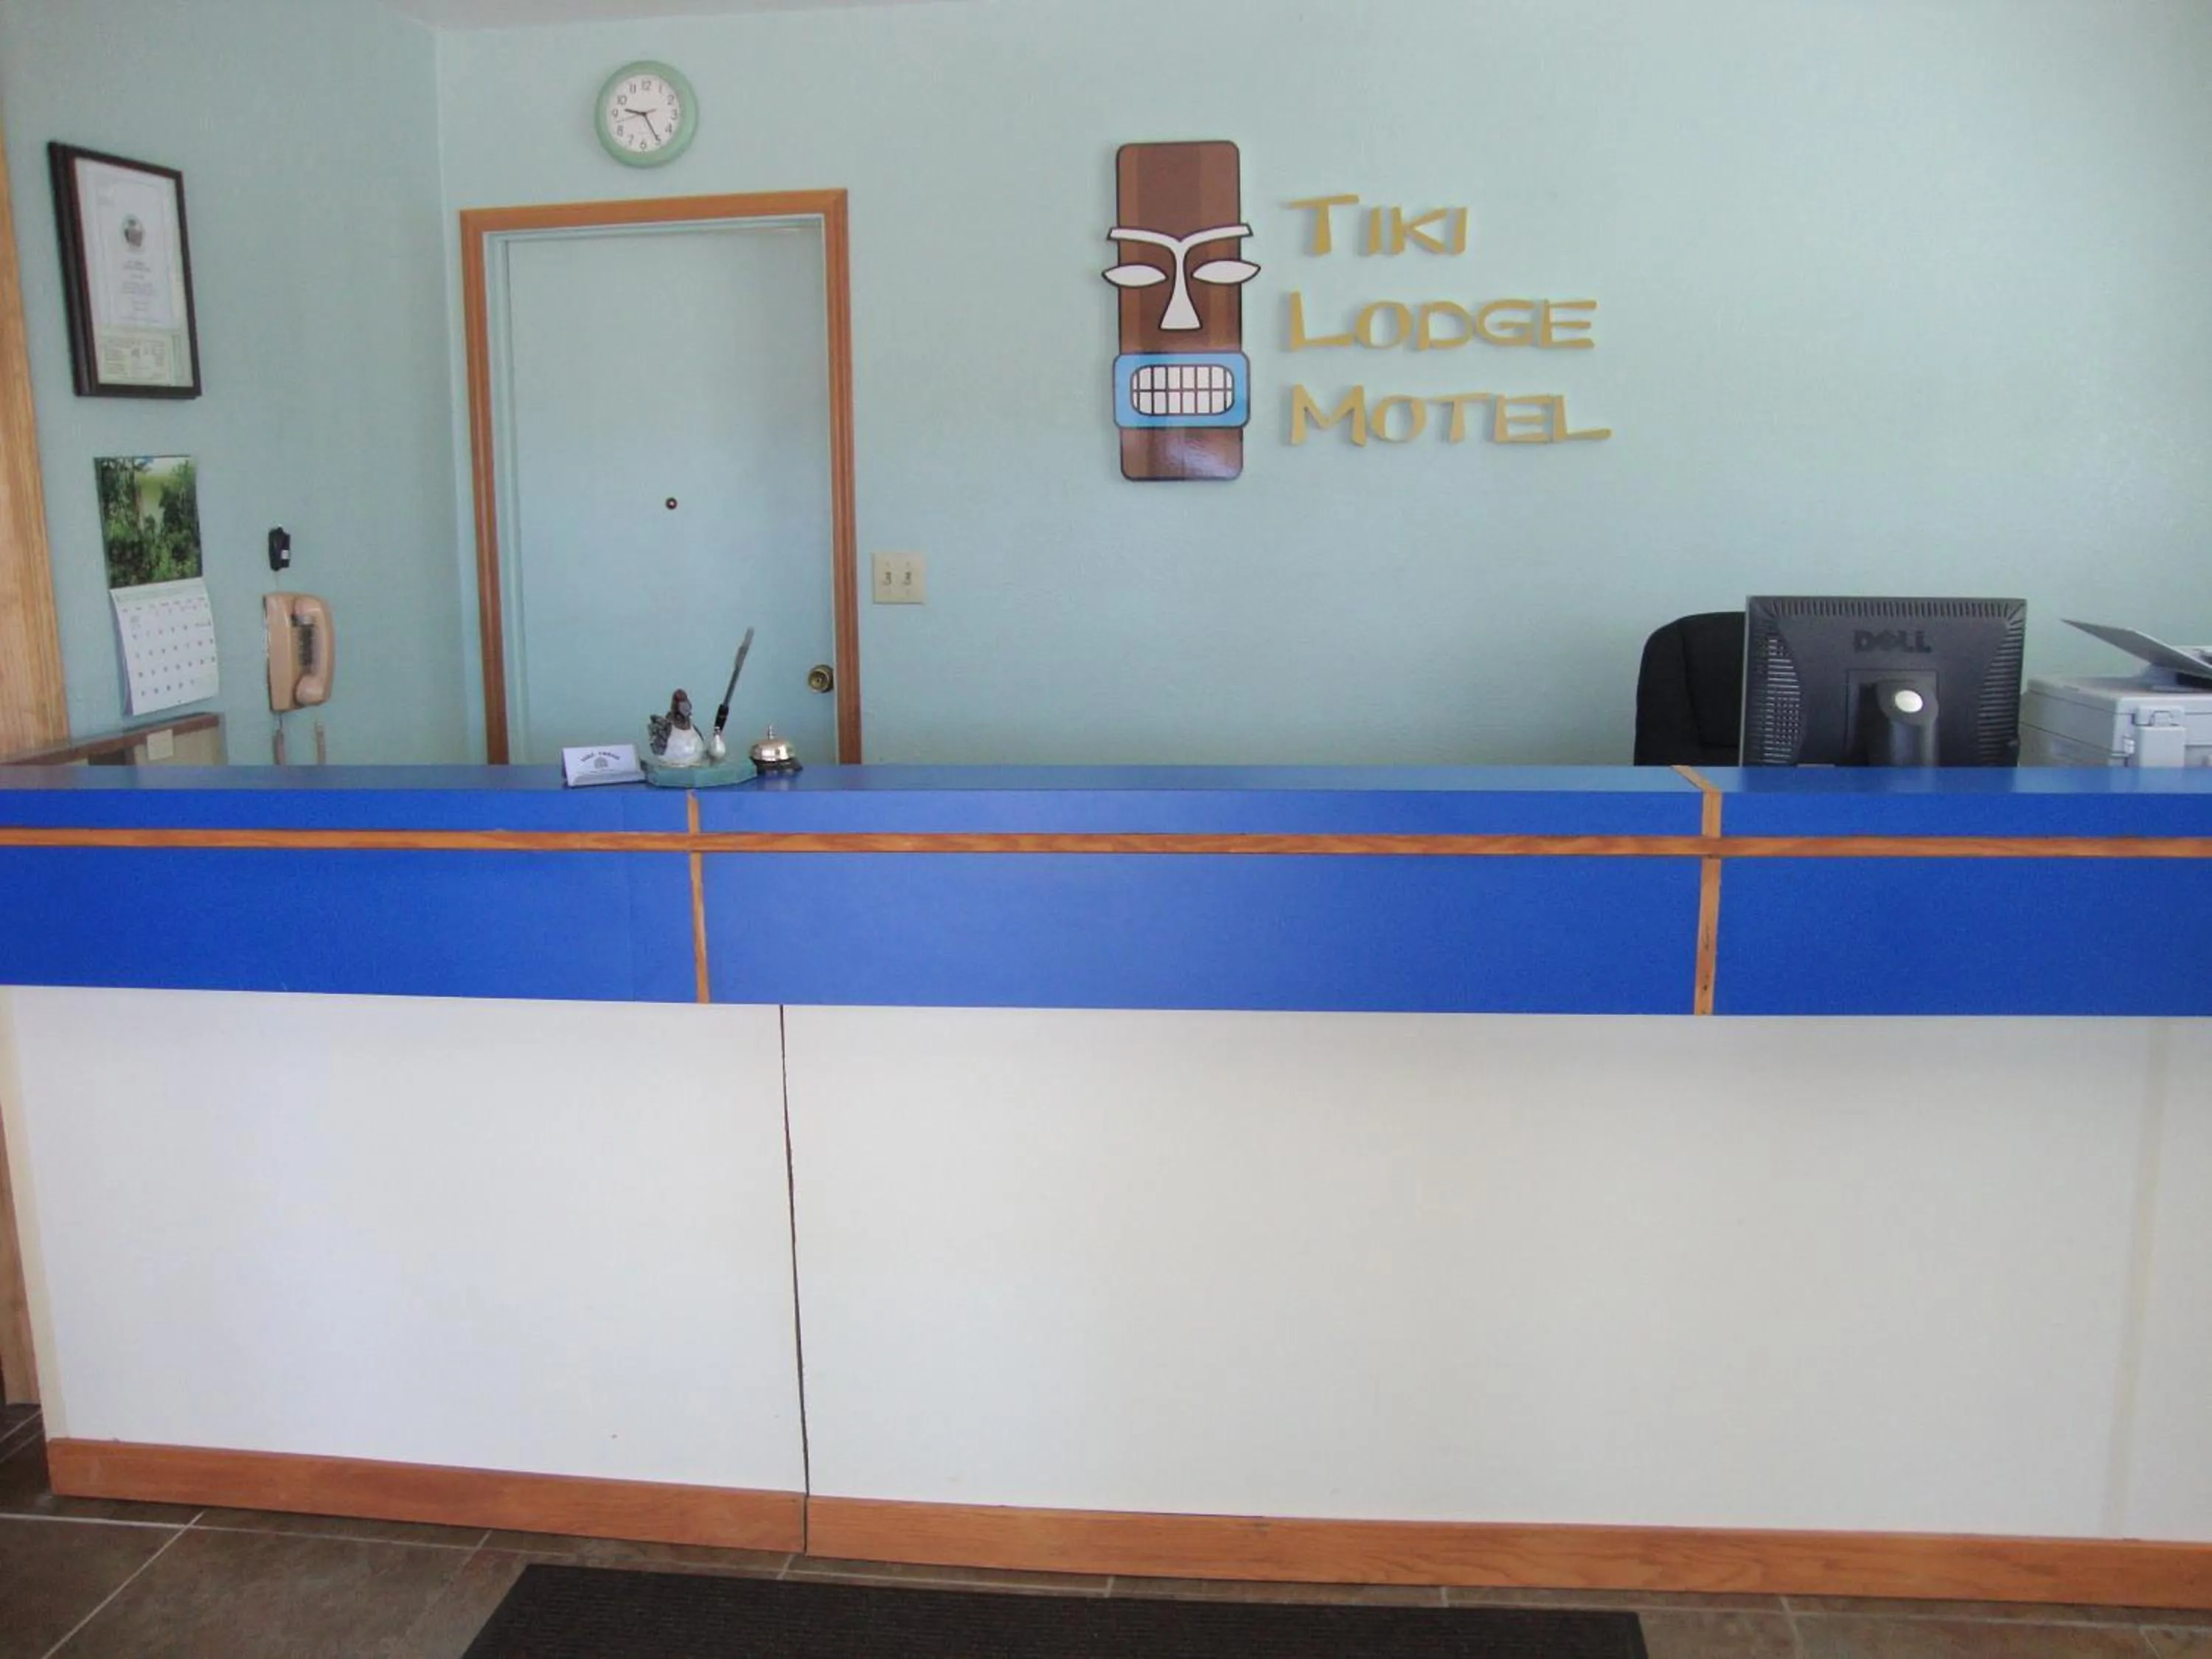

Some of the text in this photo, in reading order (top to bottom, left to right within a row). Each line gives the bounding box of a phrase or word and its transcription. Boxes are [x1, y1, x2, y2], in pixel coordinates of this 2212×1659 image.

[1286, 193, 1467, 255] TIKI
[1289, 291, 1597, 351] LODGE
[1291, 384, 1613, 446] MOTEL
[1854, 629, 1933, 653] DELL
